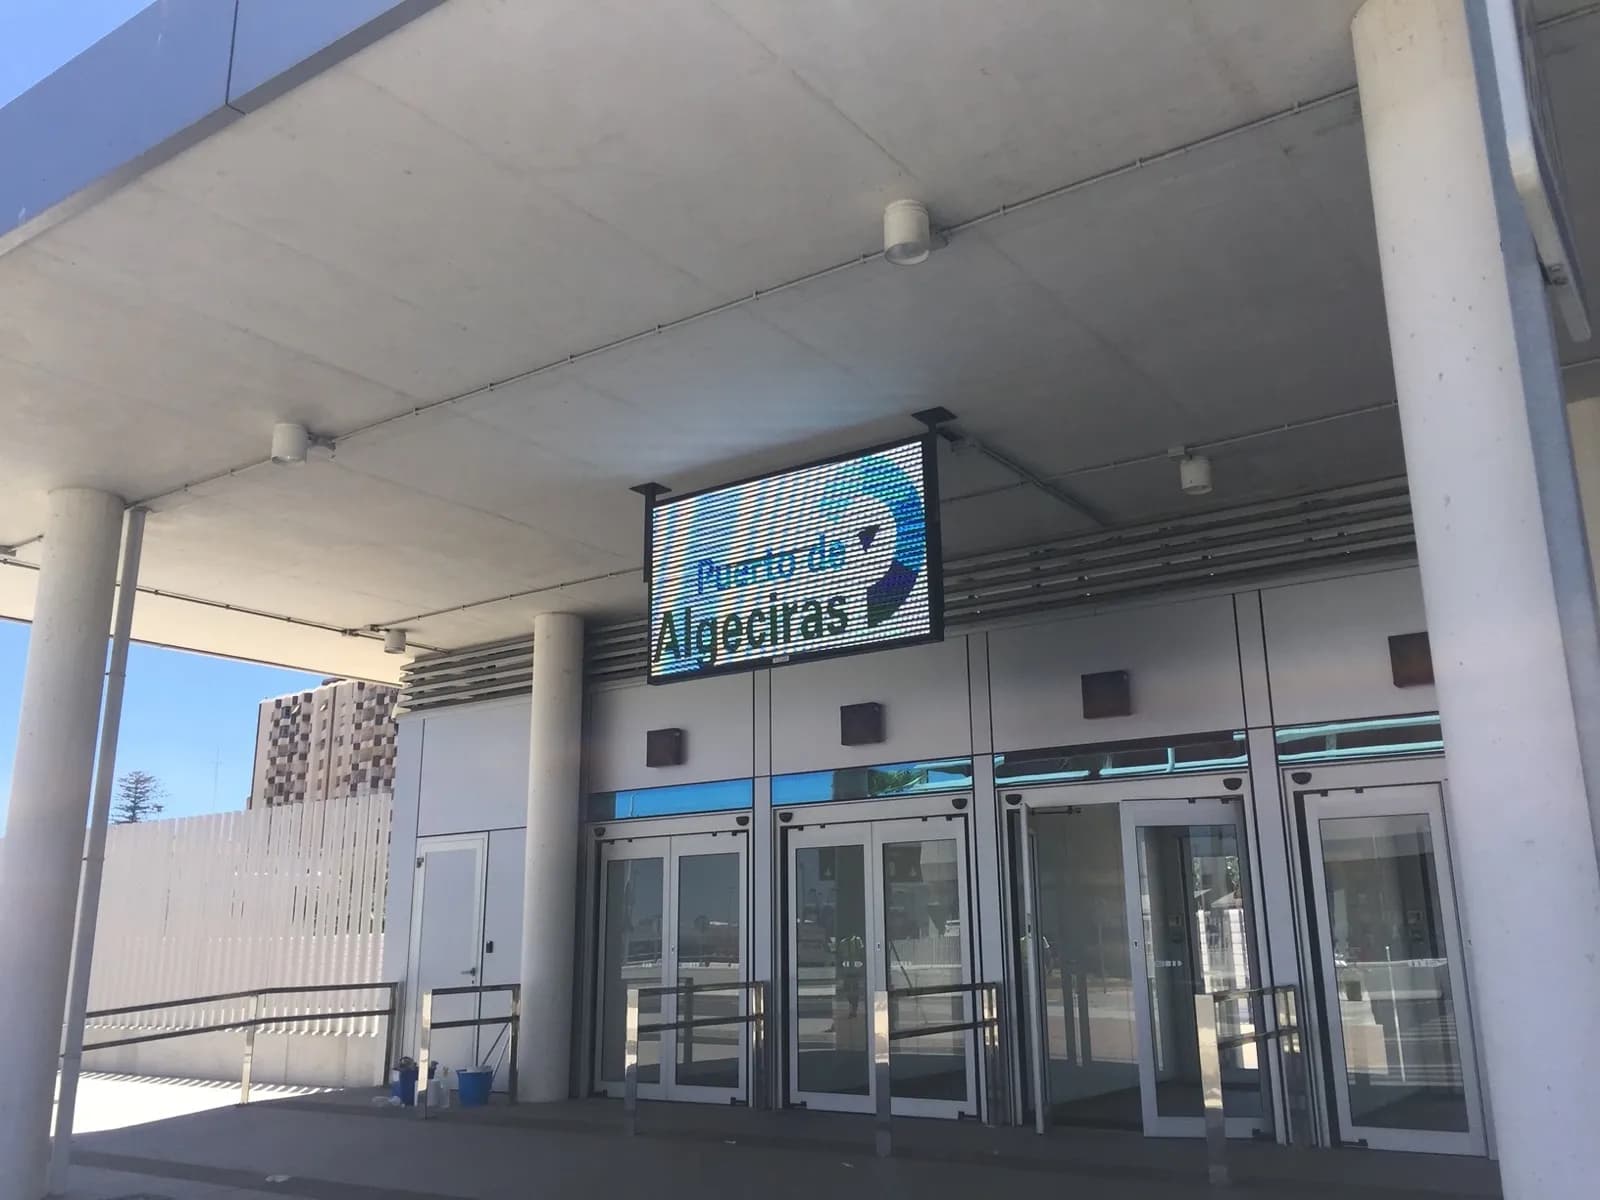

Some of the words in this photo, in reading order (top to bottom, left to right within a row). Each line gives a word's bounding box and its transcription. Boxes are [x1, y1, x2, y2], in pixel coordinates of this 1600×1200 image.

[698, 548, 796, 594] Puerto
[807, 533, 846, 572] de
[654, 592, 848, 669] Algeciras
